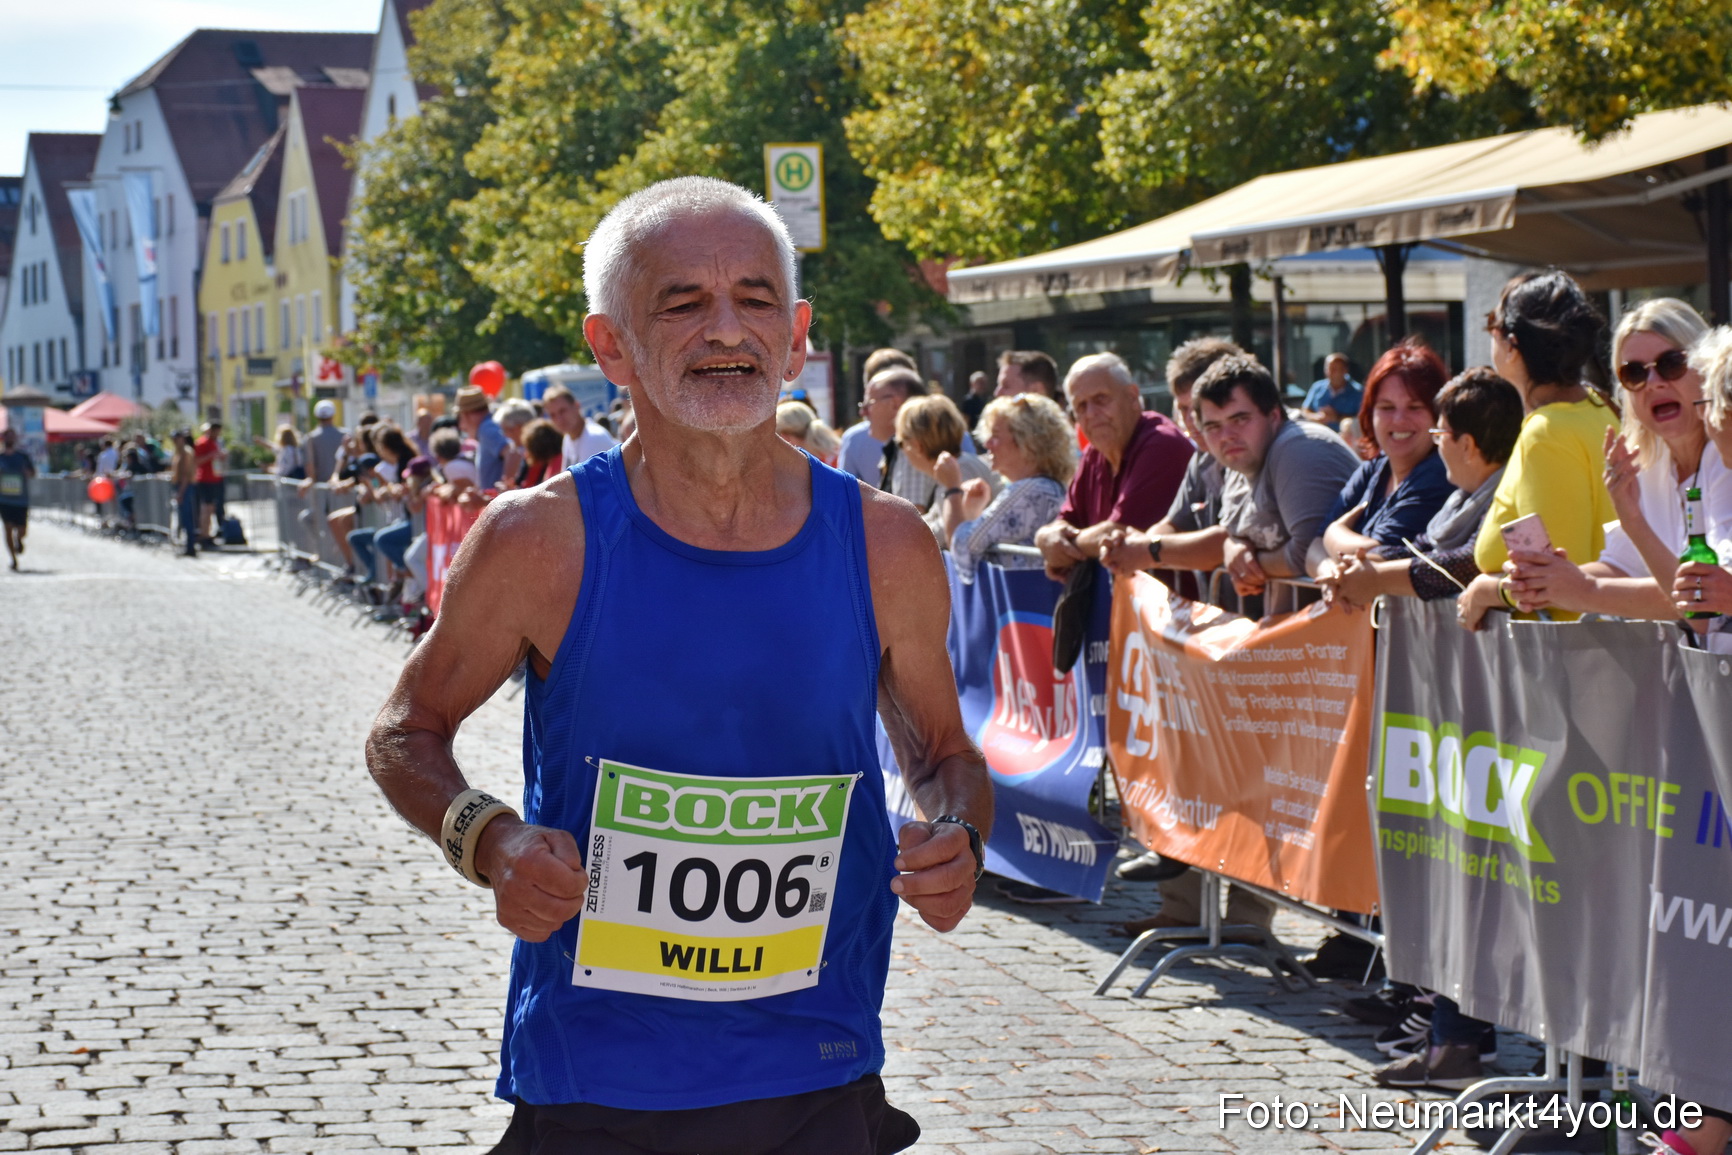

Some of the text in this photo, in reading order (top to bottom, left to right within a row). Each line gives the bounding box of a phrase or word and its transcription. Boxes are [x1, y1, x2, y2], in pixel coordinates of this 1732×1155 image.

[786, 163, 803, 181] H
[616, 777, 830, 835] BOCK
[1381, 720, 1545, 853] BOCK
[454, 794, 494, 833] GOLD
[1016, 812, 1048, 855] GET
[600, 836, 612, 914] TRANSPONDER ZEITMESSUNG
[820, 856, 830, 868] B
[623, 851, 815, 923] 1006
[660, 941, 764, 974] WILLI
[818, 1040, 857, 1055] ROSSI
